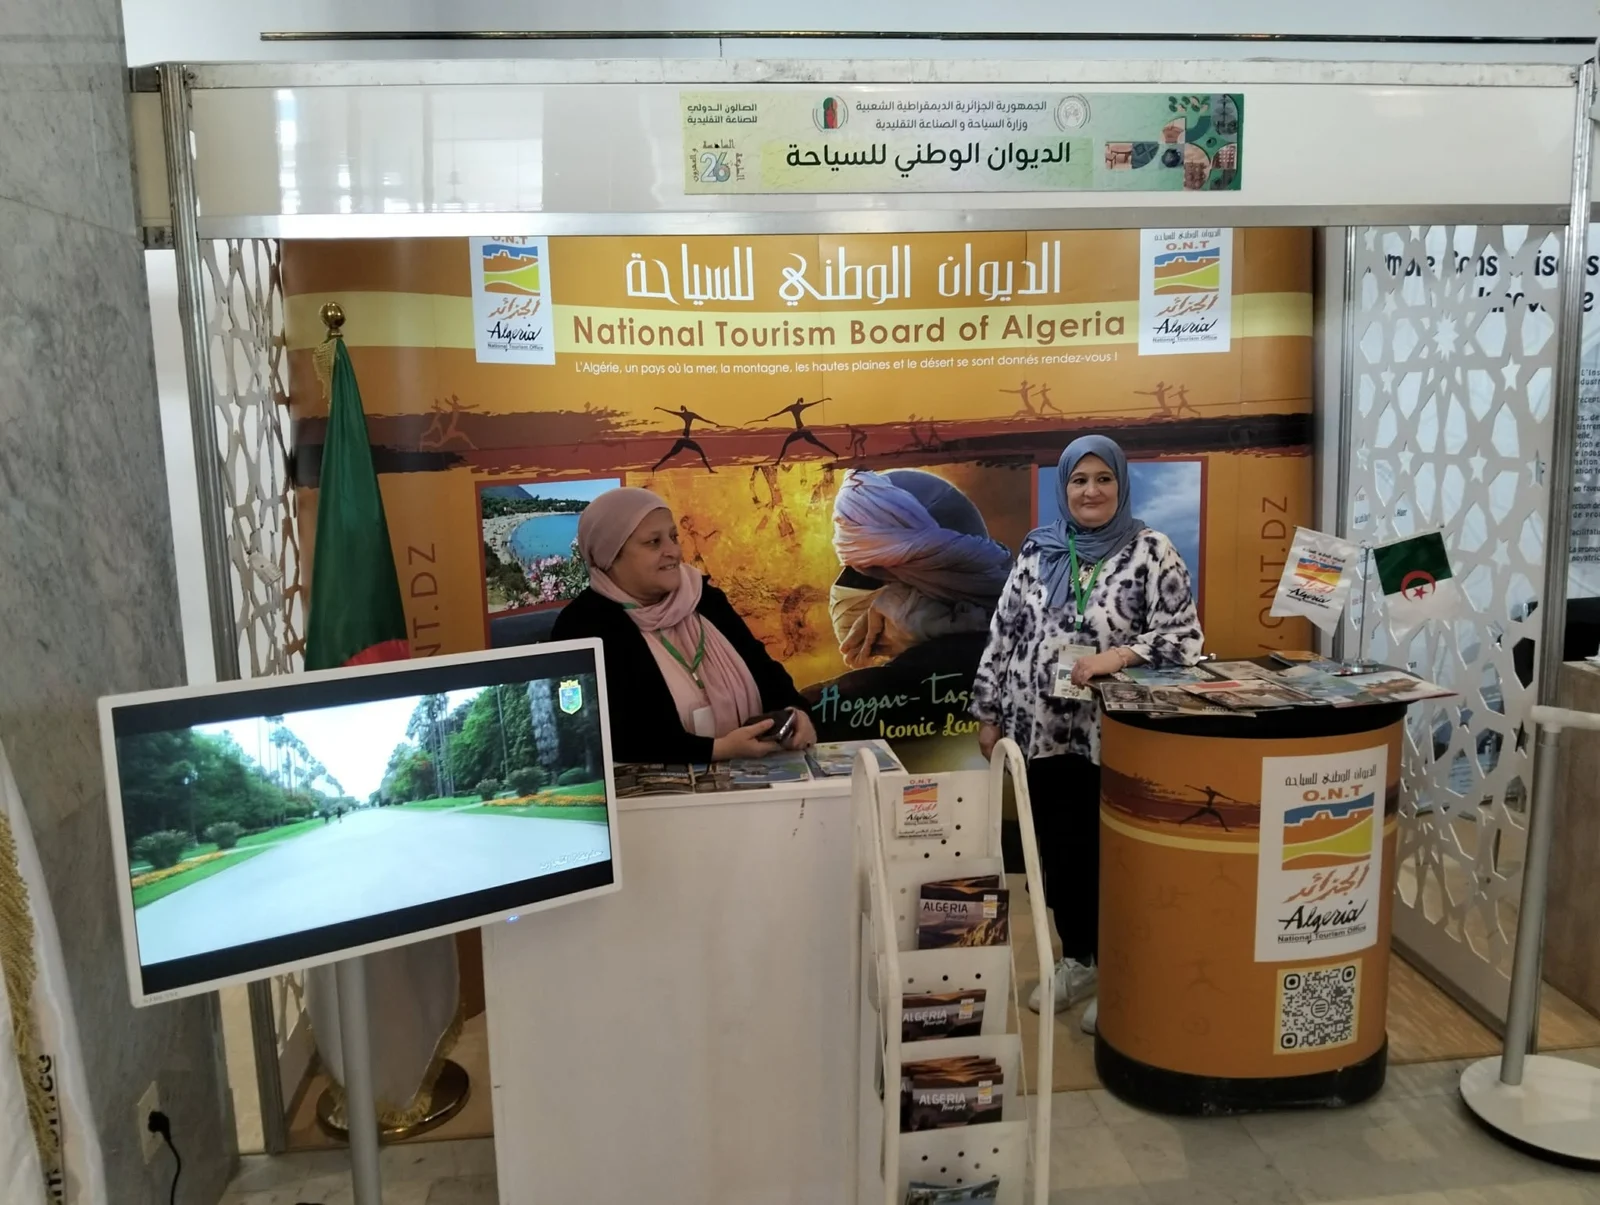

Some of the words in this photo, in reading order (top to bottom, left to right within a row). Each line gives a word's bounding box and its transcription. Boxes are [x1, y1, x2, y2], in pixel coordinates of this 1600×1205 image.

[725, 104, 757, 113] الصالون
[855, 101, 895, 112] الشعبية
[898, 100, 954, 112] الديمقراطية
[956, 100, 994, 112] الجزائرية
[996, 101, 1047, 113] الجمهورية
[687, 115, 723, 126] التقليدية
[726, 115, 757, 124] للصناعة
[876, 119, 916, 131] التقليدية
[918, 119, 957, 130] الصناعة
[960, 123, 965, 131] و
[967, 119, 1003, 130] السياحة
[1006, 119, 1028, 132] وزارة
[786, 143, 886, 172] للسياحة
[895, 142, 980, 178] الوطني
[988, 142, 1071, 171] الديوان
[700, 152, 731, 183] 26
[1165, 240, 1210, 251] O.N.T
[625, 243, 754, 306] للسياحة
[778, 244, 911, 306] الوطني
[938, 240, 1061, 302] الديوان
[486, 321, 543, 344] Algeria
[573, 315, 703, 346] National
[715, 320, 835, 347] Tourism
[850, 316, 945, 345] Board
[958, 314, 989, 341] of
[1001, 311, 1125, 345] Algeria
[1152, 317, 1218, 337] Algeria
[575, 361, 622, 376] L'Algérie,
[625, 364, 638, 373] un
[641, 364, 665, 376] pays
[667, 362, 681, 374] où
[683, 363, 693, 374] la
[696, 364, 717, 375] mer,
[720, 363, 730, 374] la
[733, 363, 792, 376] montagne,
[795, 362, 809, 372] les
[812, 360, 849, 372] hautes
[851, 358, 890, 372] plaines
[893, 360, 904, 370] et
[907, 358, 917, 369] le
[920, 357, 954, 369] désert
[956, 359, 969, 368] se
[971, 356, 994, 367] sont
[997, 353, 1039, 366] donnés
[1041, 351, 1111, 365] rendez-vous
[879, 716, 937, 739] Iconic
[1302, 784, 1363, 802] O.N.T
[1282, 862, 1370, 904] الجزائر
[923, 902, 968, 914] ALGERIA
[1278, 898, 1369, 934] Algeria
[1278, 934, 1312, 942] National
[1315, 930, 1346, 940] Tourism
[1346, 924, 1367, 935] Office
[902, 1009, 947, 1022] ALGERIA
[919, 1092, 966, 1105] ALGERIA
